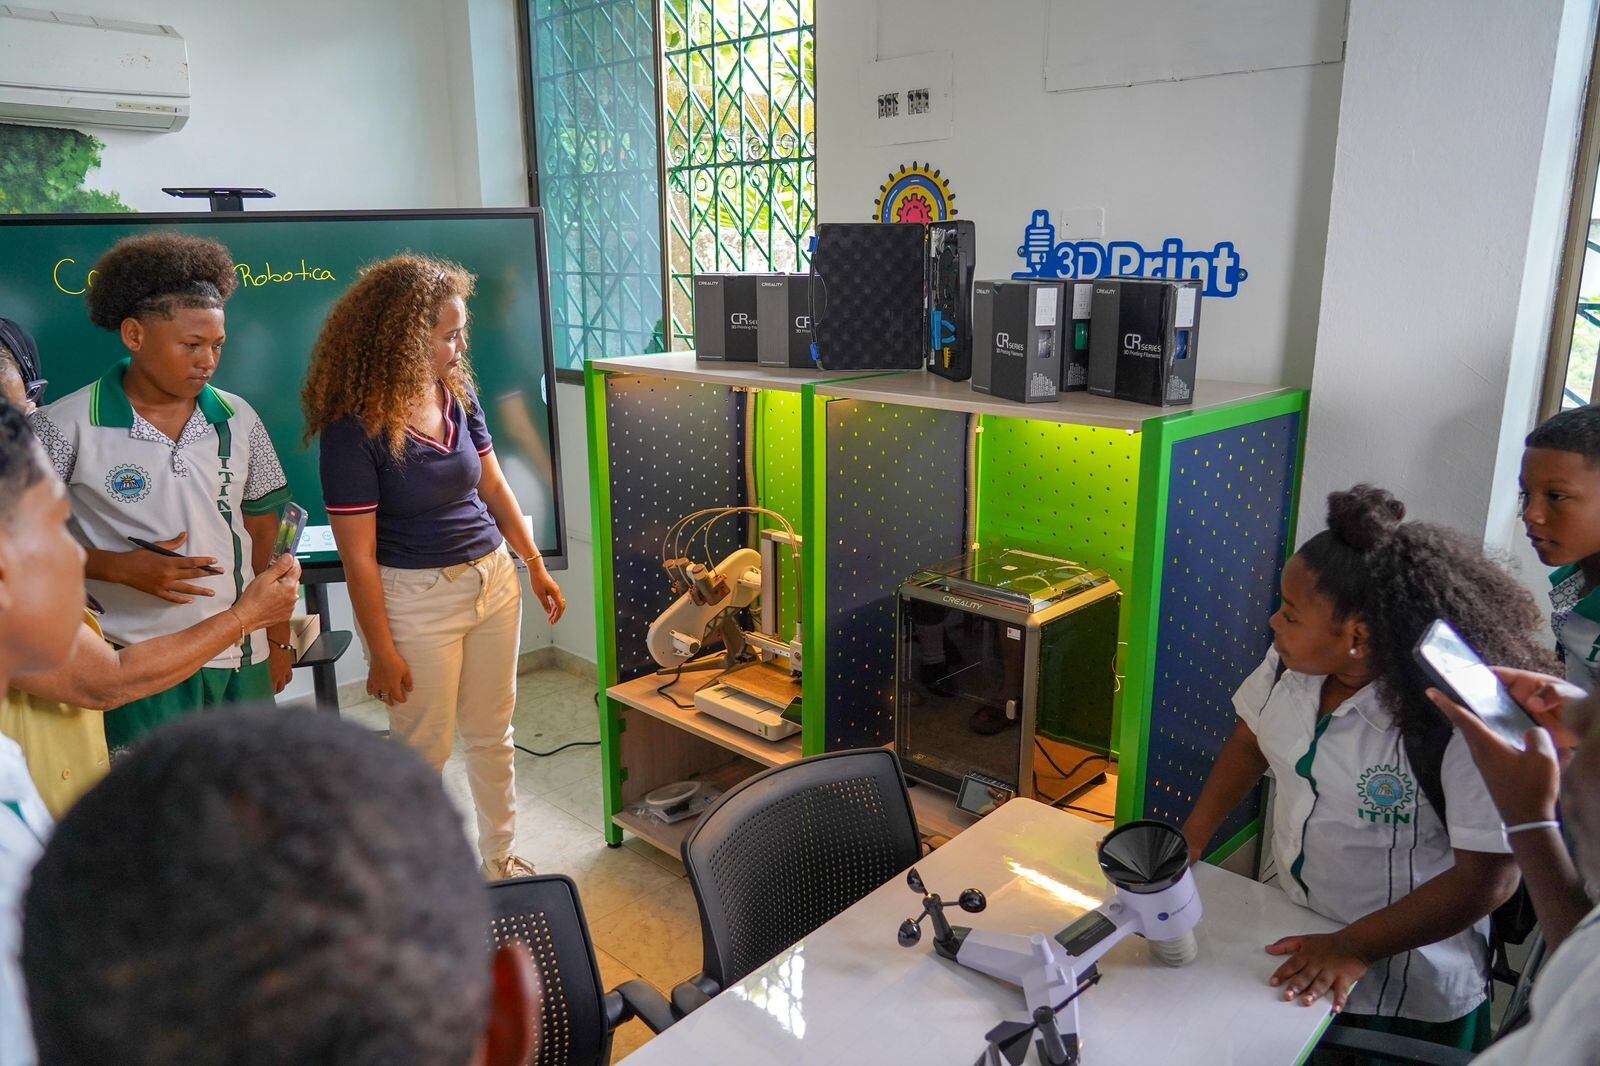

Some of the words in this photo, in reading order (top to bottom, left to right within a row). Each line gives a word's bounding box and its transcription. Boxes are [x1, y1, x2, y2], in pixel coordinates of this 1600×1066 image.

[1056, 246, 1102, 280] 3D
[232, 259, 336, 288] Robotica
[731, 313, 748, 325] CR
[996, 332, 1009, 349] CR
[1009, 342, 1024, 351] SERIES
[1124, 333, 1141, 350] CR
[1141, 343, 1162, 353] SERIES
[942, 595, 983, 610] CREALITY
[1358, 807, 1410, 824] ITIN
